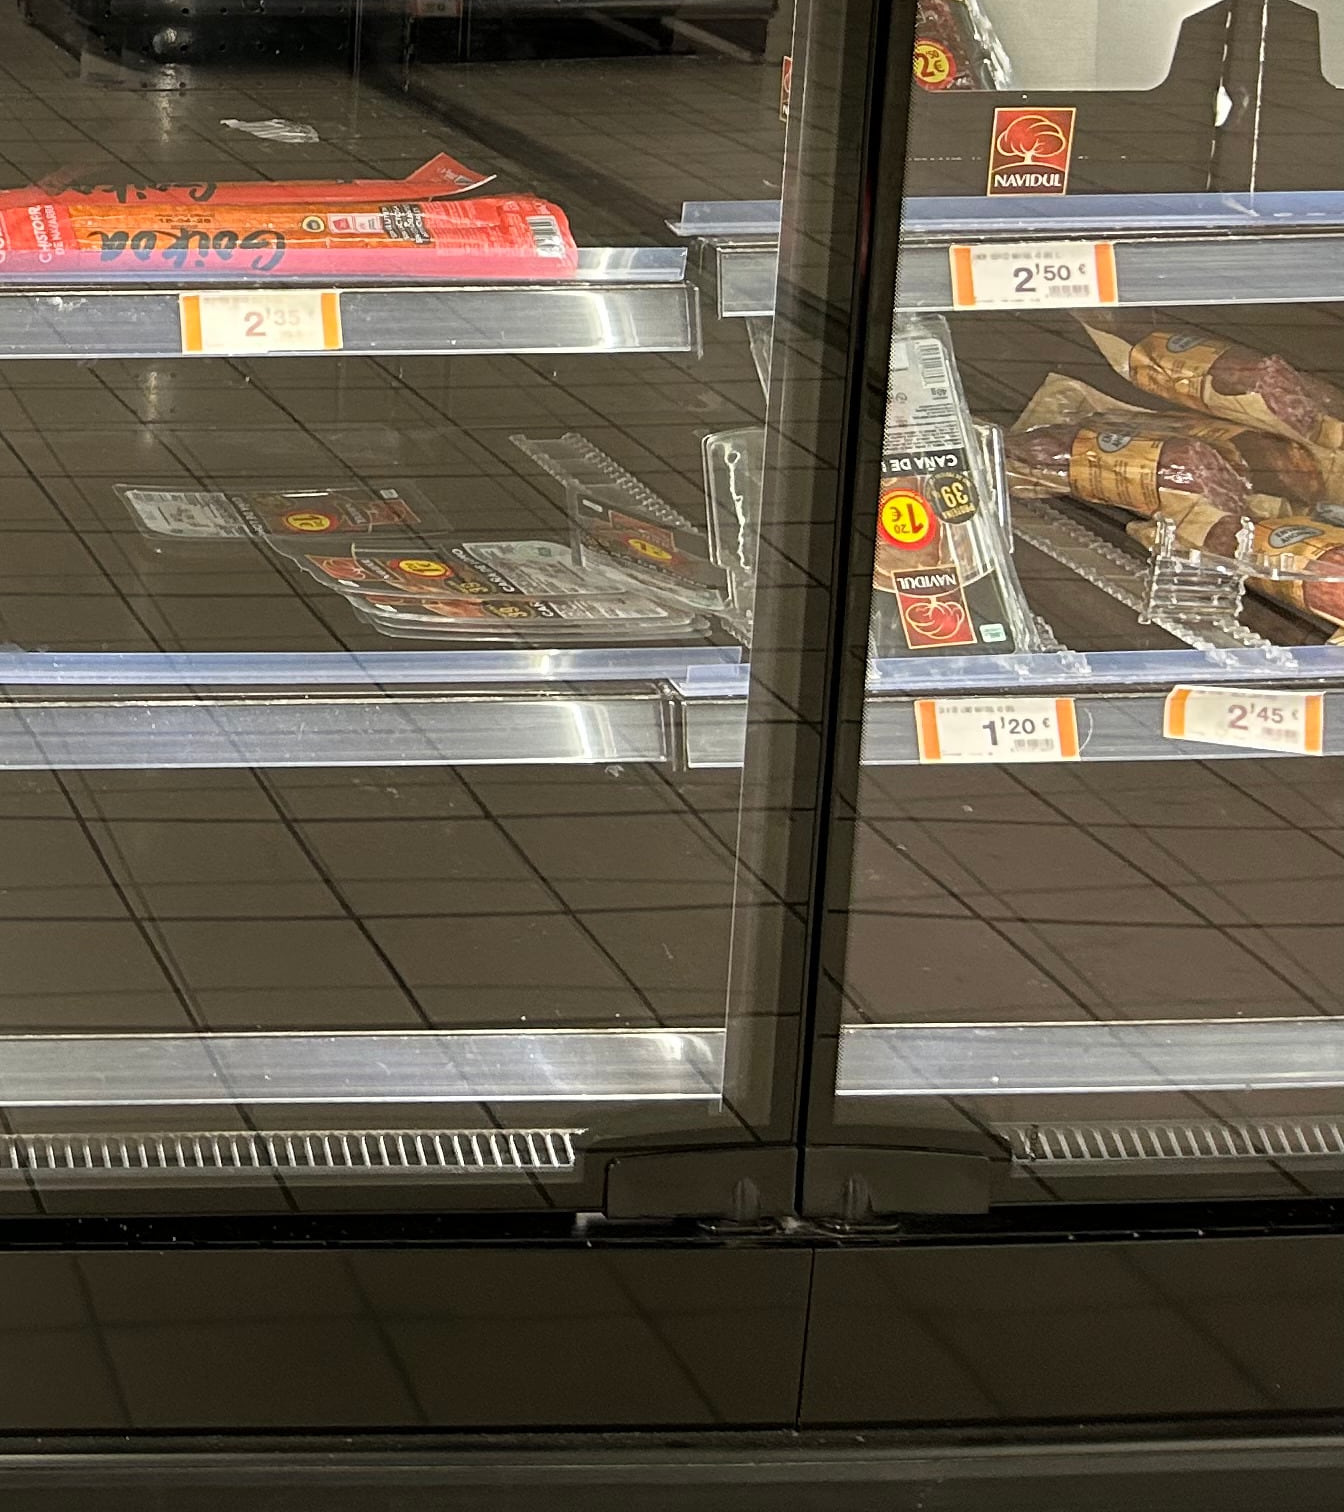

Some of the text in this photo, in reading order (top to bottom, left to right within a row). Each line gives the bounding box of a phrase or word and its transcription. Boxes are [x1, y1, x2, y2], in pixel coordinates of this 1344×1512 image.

[994, 173, 1062, 188] NAVIDUL
[1012, 262, 1071, 293] 2'50
[891, 453, 959, 471] CAÑA DE
[896, 574, 957, 588] NAVIDUL
[982, 717, 1036, 746] 1'20
